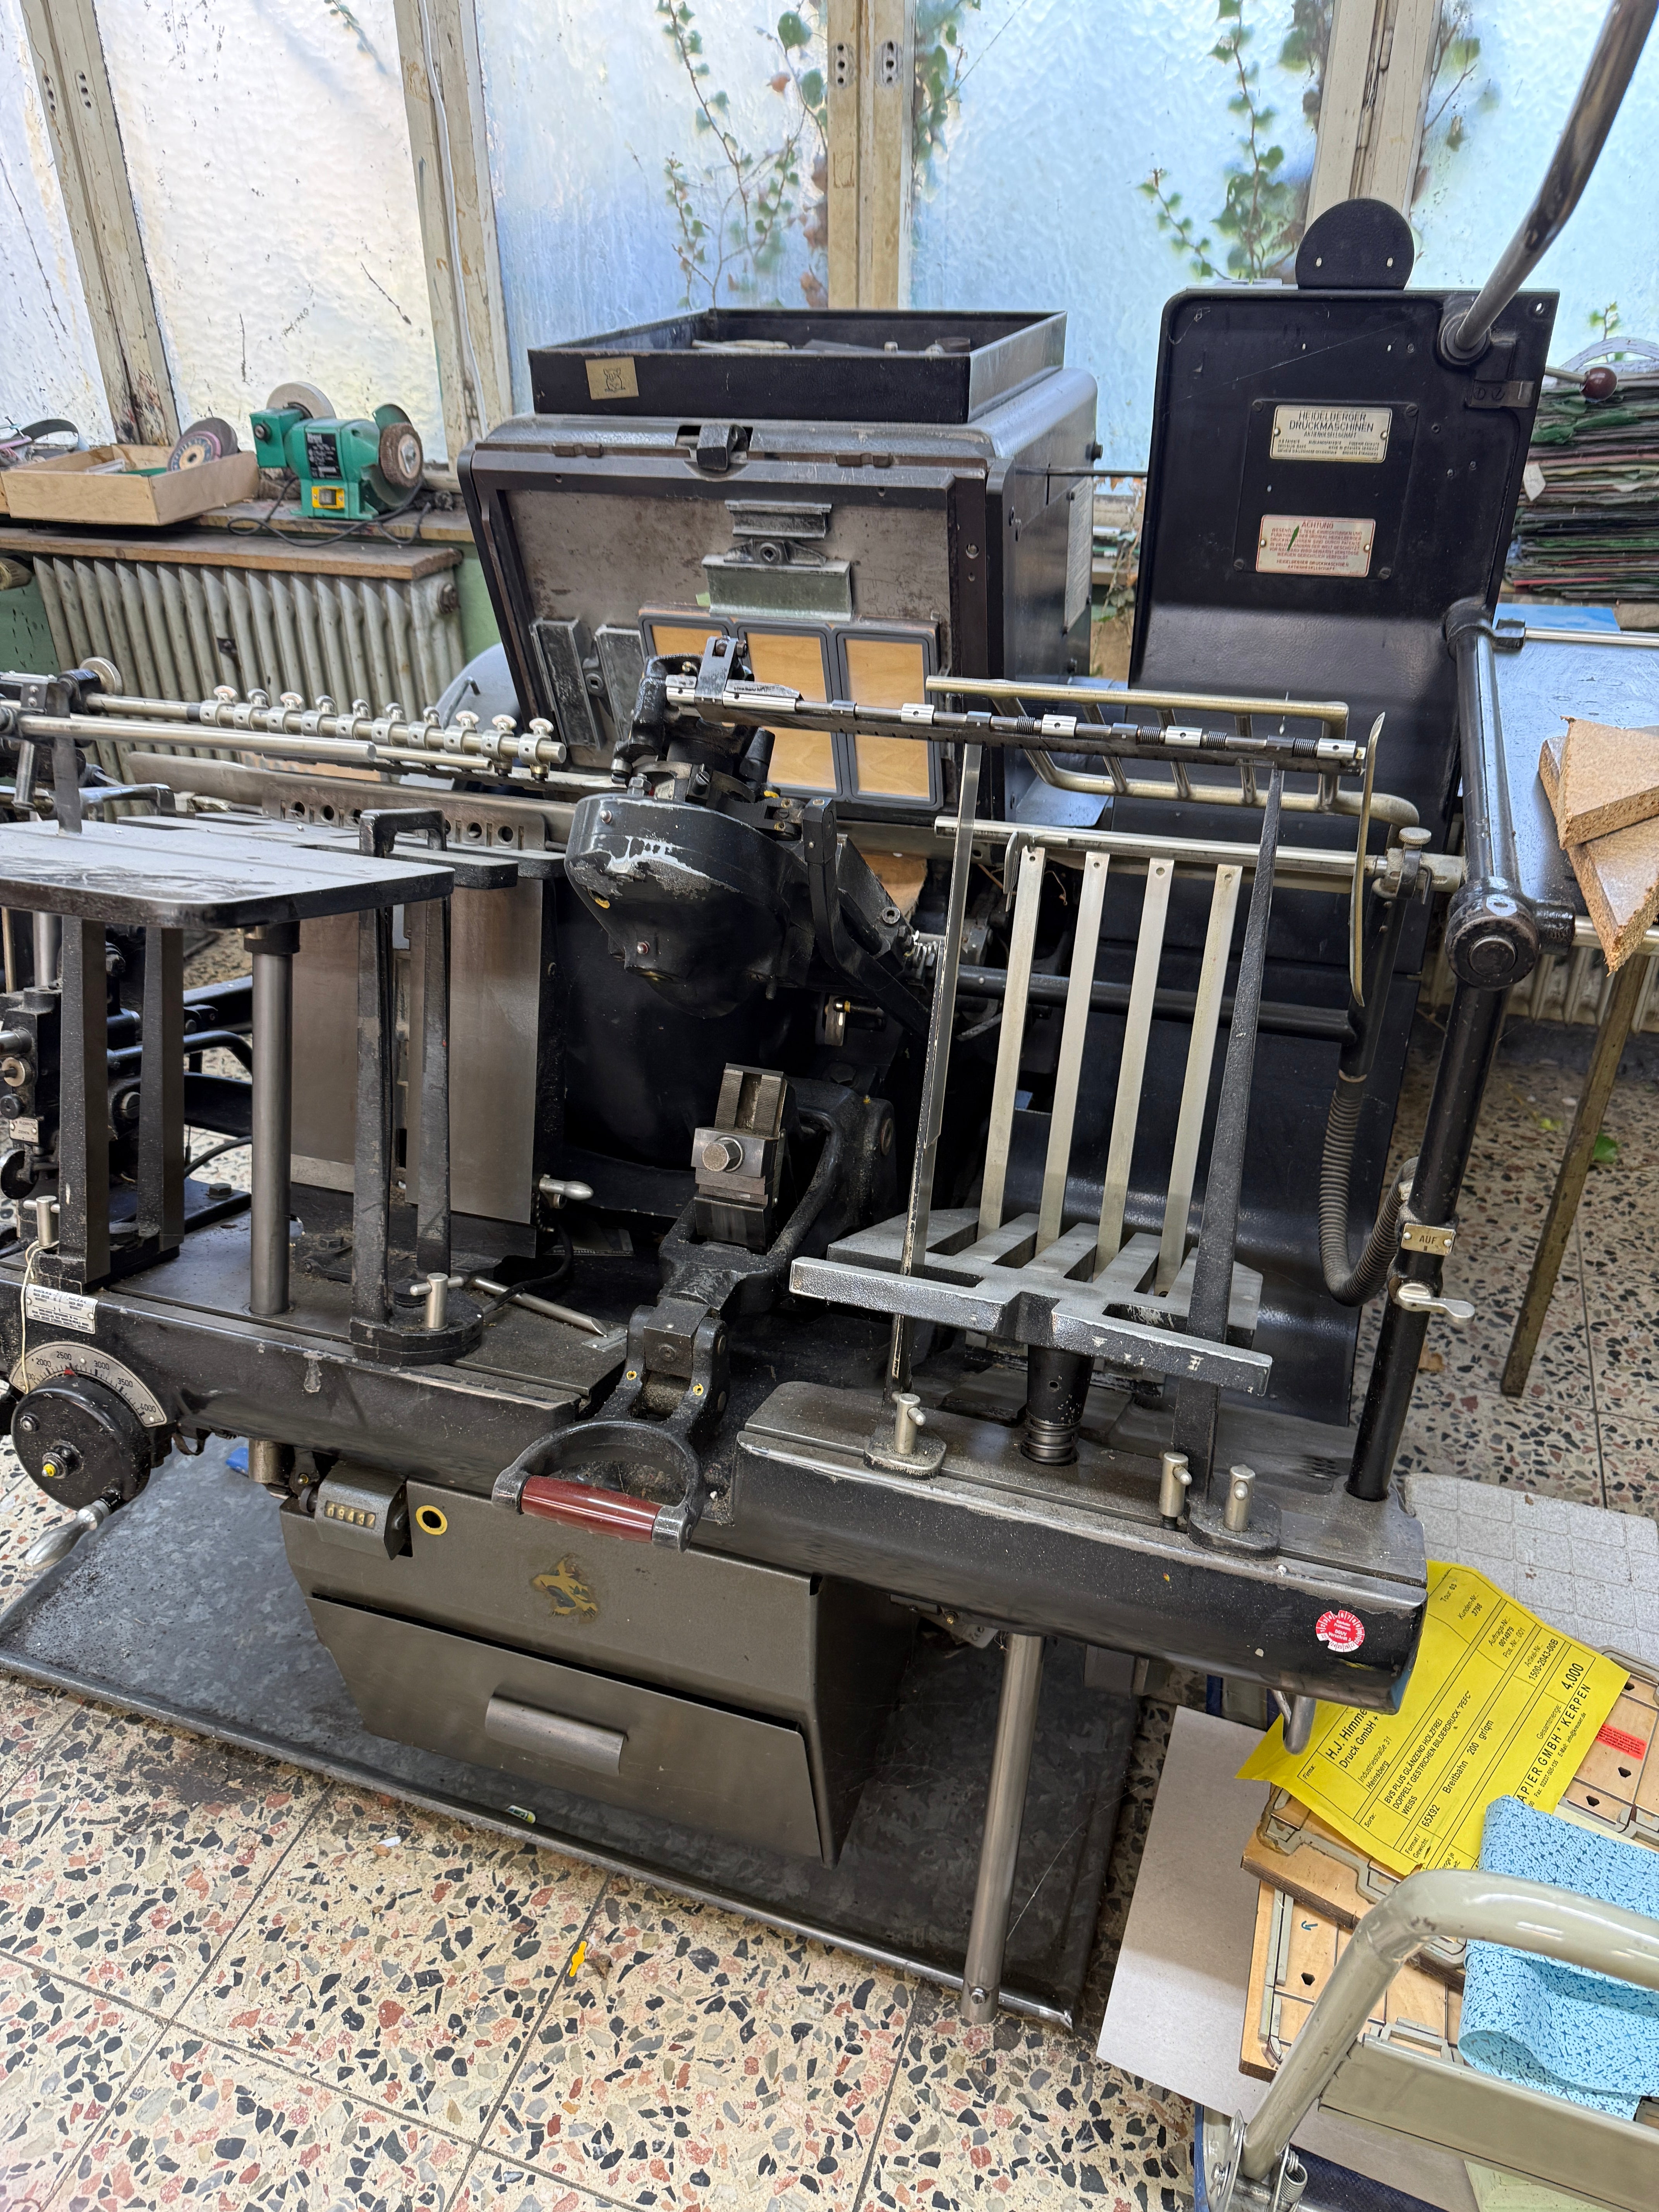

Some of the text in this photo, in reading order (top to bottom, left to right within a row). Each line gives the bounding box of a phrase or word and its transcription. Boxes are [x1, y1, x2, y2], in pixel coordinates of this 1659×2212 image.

[1298, 409, 1366, 422] HEIDELBERGER
[1289, 420, 1374, 433] DRUCKMASCHINEN
[1419, 1235, 1437, 1244] AUF
[36, 1358, 51, 1367] 2000
[56, 1351, 72, 1360] 2500
[94, 1360, 110, 1370] 3000
[117, 1377, 133, 1388] 3500
[140, 1403, 156, 1413] 4000
[1471, 1602, 1483, 1617] 3798
[1498, 1626, 1515, 1647] 0014979
[1516, 1627, 1525, 1638] 001
[1528, 1638, 1559, 1681] 1500-2043-00B
[1561, 1662, 1584, 1690] 4.000
[1339, 1709, 1367, 1741] Himme
[1339, 1745, 1360, 1769] Druck
[1355, 1720, 1376, 1745] GmbH
[1516, 1766, 1543, 1803] APIER
[1538, 1733, 1562, 1766] GMBH
[1560, 1683, 1591, 1728] KERPEN
[1358, 1735, 1392, 1783] Industriestraße 31
[1384, 1718, 1443, 1804] BVS PLUS GLÄNZEND HOLZFREI
[1392, 1781, 1413, 1810] DOPPELT
[1410, 1746, 1437, 1783] GESTRICHEN
[1432, 1709, 1461, 1748] BILDERDRUCK
[1366, 1760, 1390, 1790] Heinsberg
[1421, 1720, 1494, 1827] 65X92 Breitbahn 200 gr/qm
[1401, 1795, 1418, 1815] WEISS
[1405, 1836, 1419, 1855] Format
